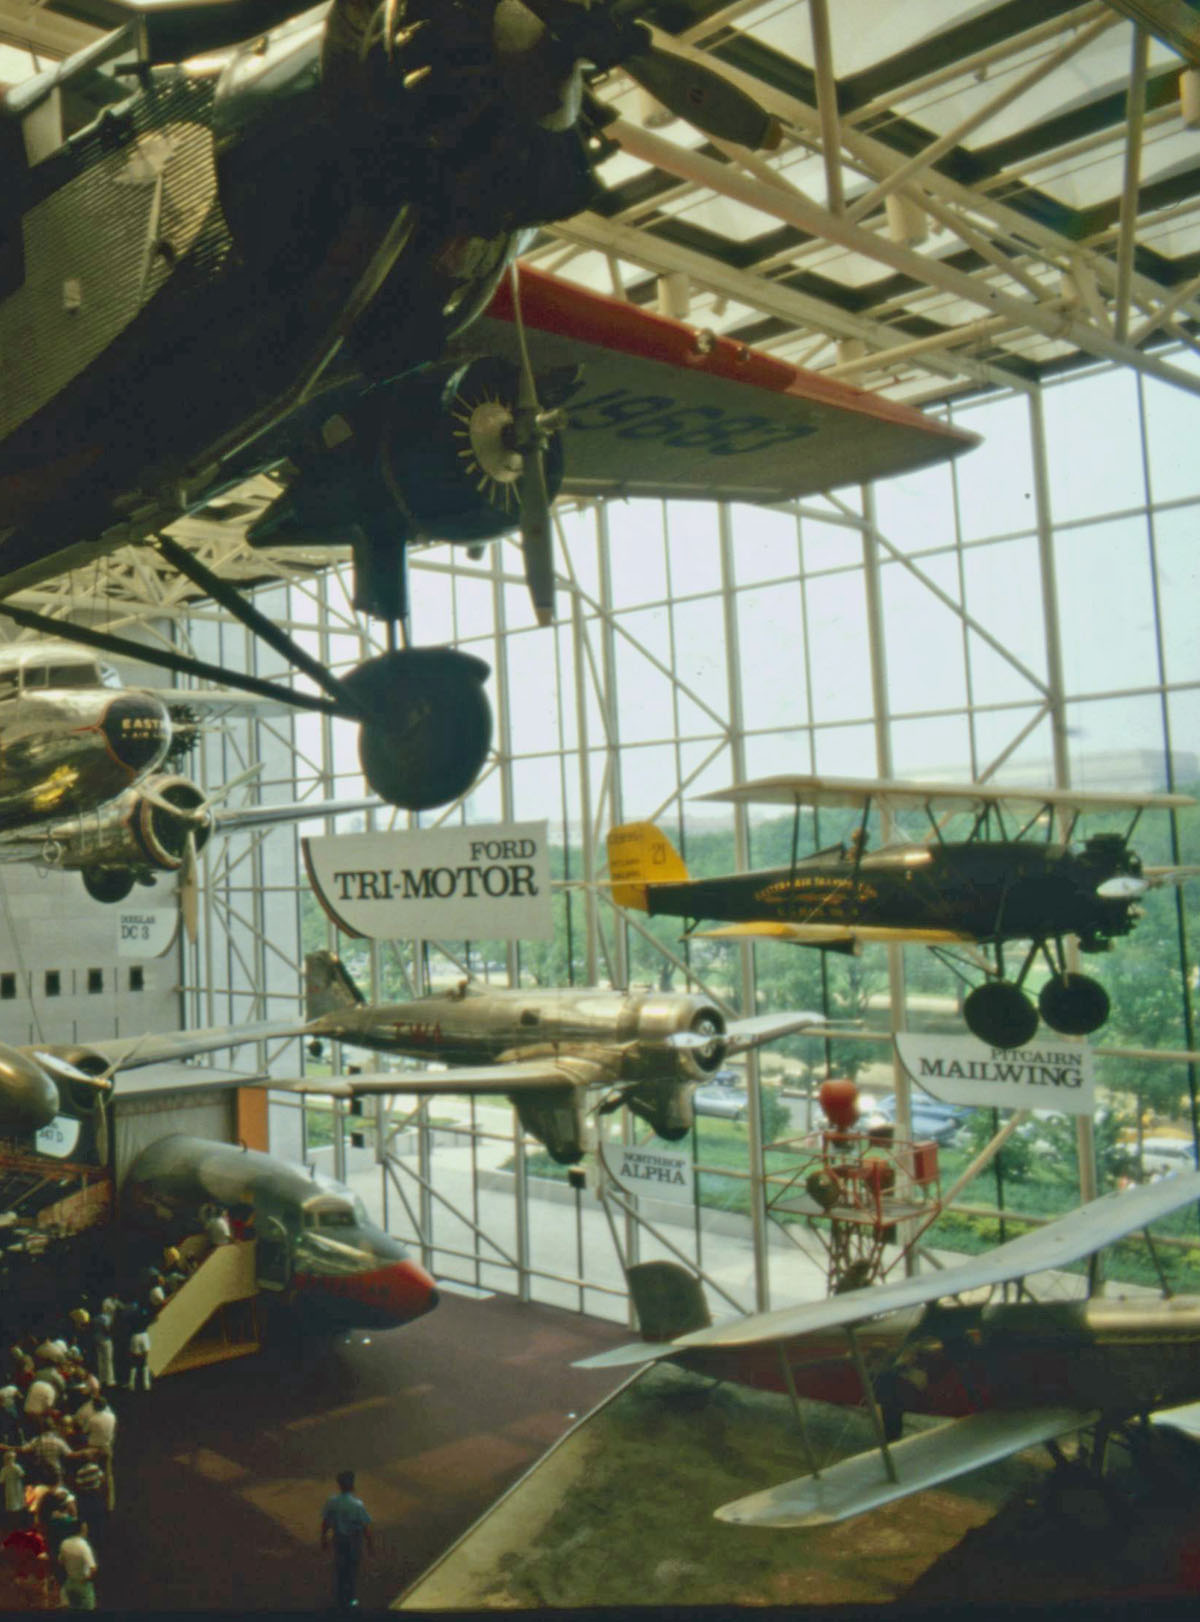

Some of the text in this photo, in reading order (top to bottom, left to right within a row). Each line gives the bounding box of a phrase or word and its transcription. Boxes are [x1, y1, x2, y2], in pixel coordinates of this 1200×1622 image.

[469, 839, 538, 862] FORD
[333, 864, 539, 901] TRI-MOTOR
[121, 925, 150, 940] DC 3
[990, 1048, 1082, 1067] PITCAIRN
[919, 1057, 1084, 1089] MAILWING
[621, 1162, 686, 1186] ALPHA
